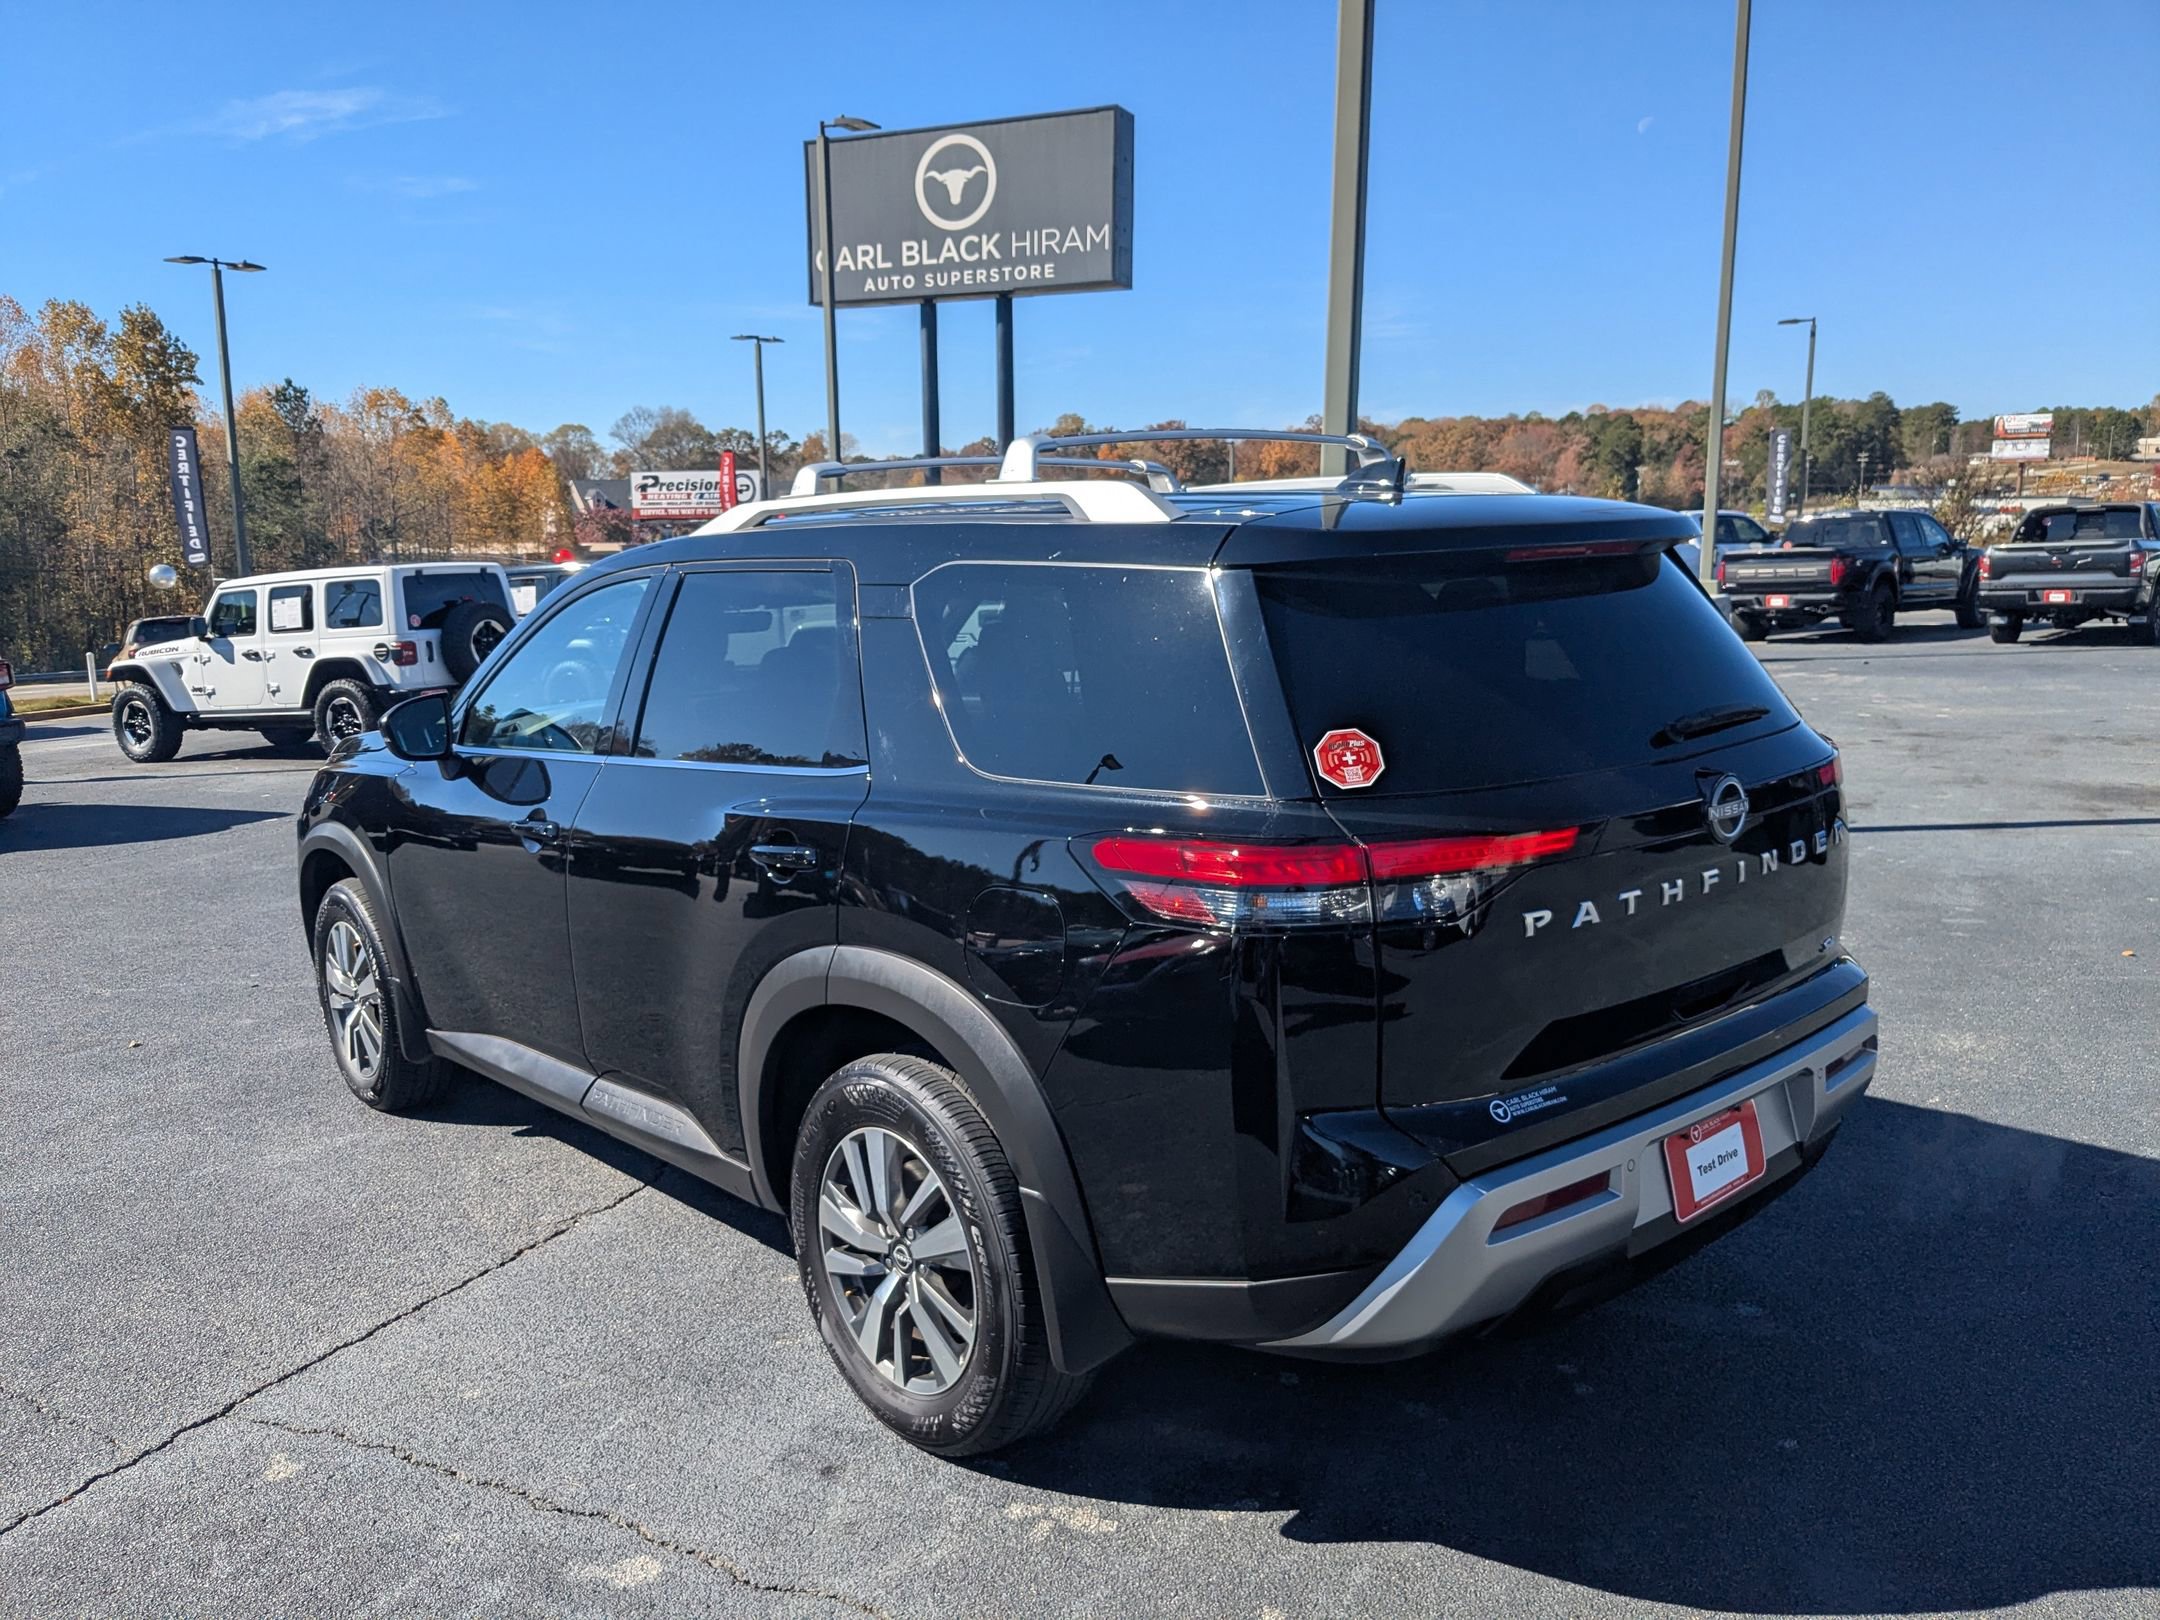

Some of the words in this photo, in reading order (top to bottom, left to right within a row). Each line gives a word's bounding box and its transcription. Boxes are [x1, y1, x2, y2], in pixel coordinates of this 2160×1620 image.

[901, 232, 1001, 266] BLACK
[1011, 223, 1110, 258] HIRAM
[863, 274, 915, 292] AUTO
[924, 263, 1056, 288] SUPERSTORE
[1772, 434, 1787, 514] CERTIFIED
[138, 646, 179, 657] RUBICON
[1708, 799, 1749, 819] NISSAN
[1697, 1158, 1717, 1177] Test
[1717, 1148, 1739, 1167] Drive
